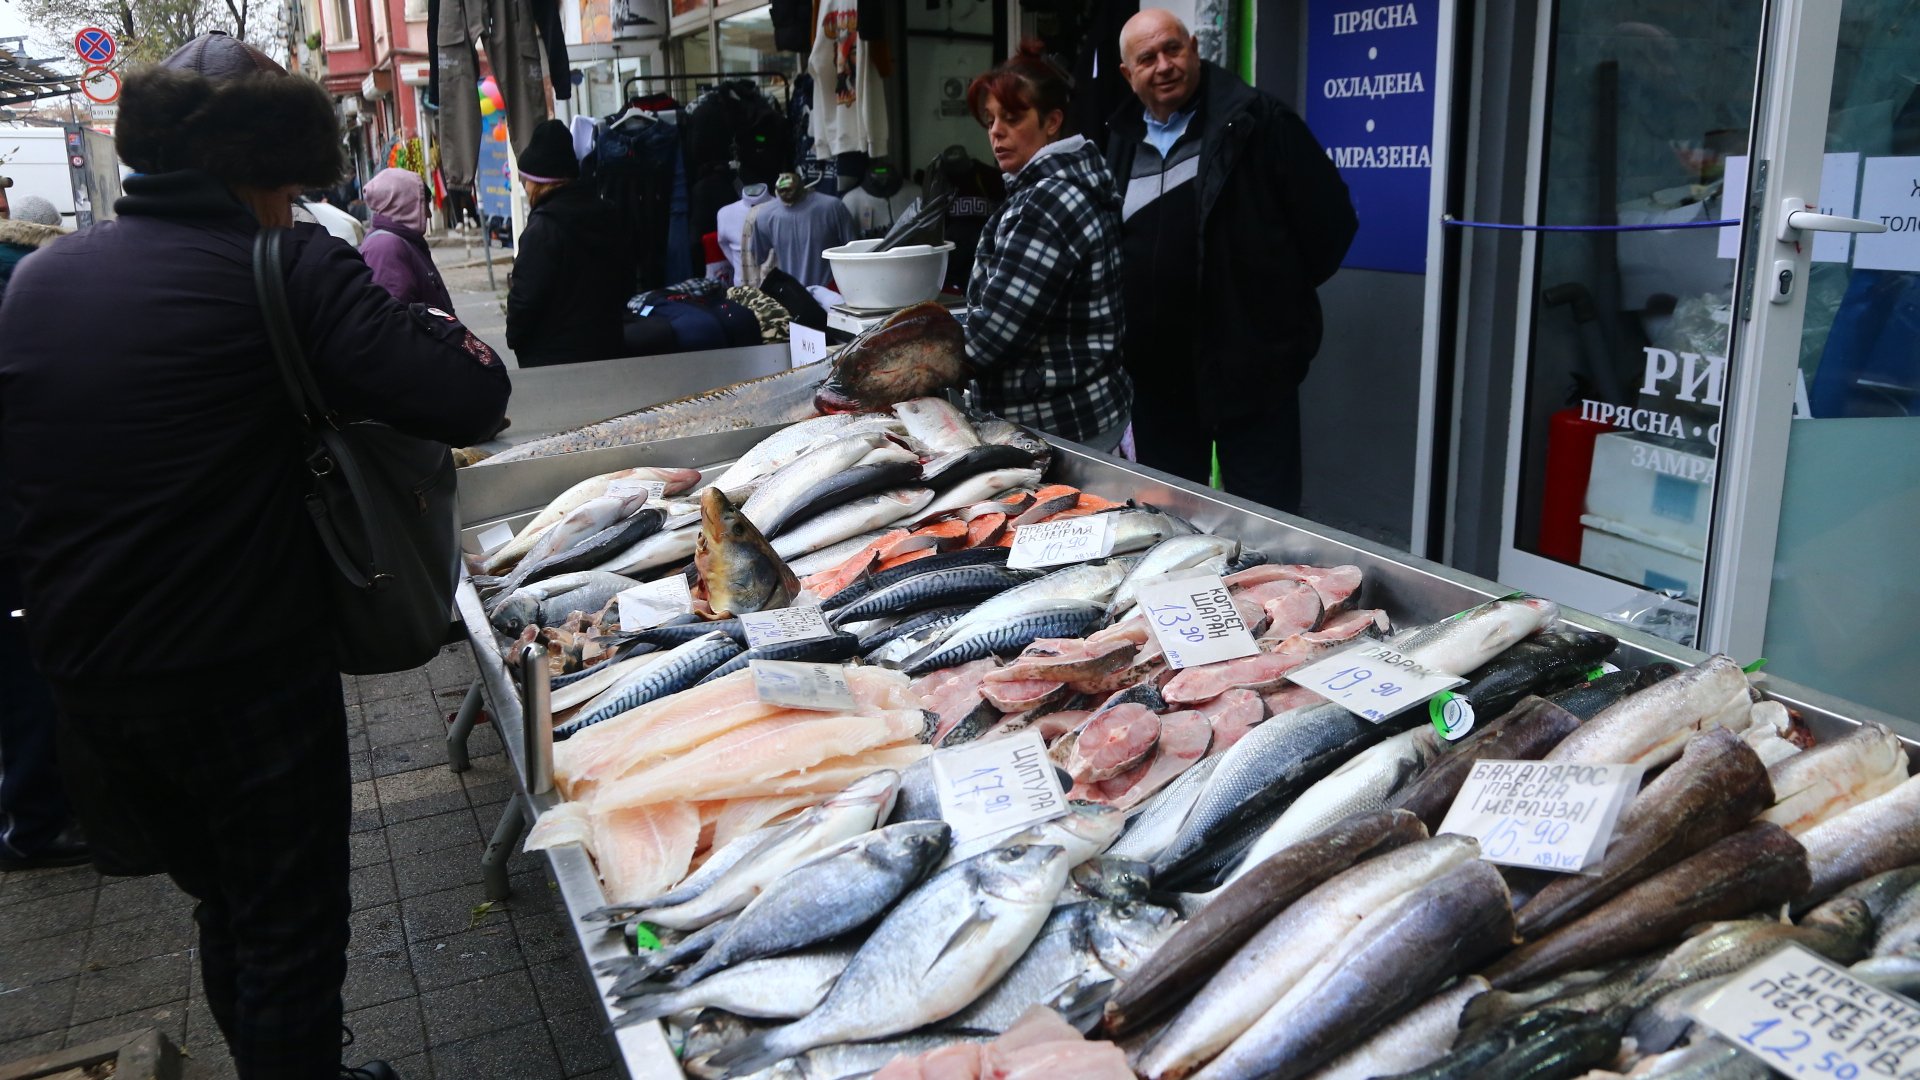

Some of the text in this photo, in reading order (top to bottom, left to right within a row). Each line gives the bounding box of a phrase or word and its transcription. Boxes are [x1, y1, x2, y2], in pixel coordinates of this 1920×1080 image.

[1333, 3, 1418, 35] ПРЯСНА
[1323, 71, 1425, 100] ОХЛАДЕНА
[1326, 145, 1431, 168] МРАЗЕНА
[1580, 399, 1686, 440] ПРЯСНА
[1631, 444, 1716, 484] ЗАМРА
[1017, 525, 1093, 544] СКУМРИЯ
[1019, 520, 1073, 536] ПРЕСНА
[1190, 592, 1230, 639] ШАРАН
[1209, 587, 1245, 631] КОТЛЕТ
[1010, 745, 1056, 811] ЦИПУРА
[1472, 764, 1608, 786] БАКАЛЯРОС
[1806, 965, 1920, 1030] ПРЕСНА
